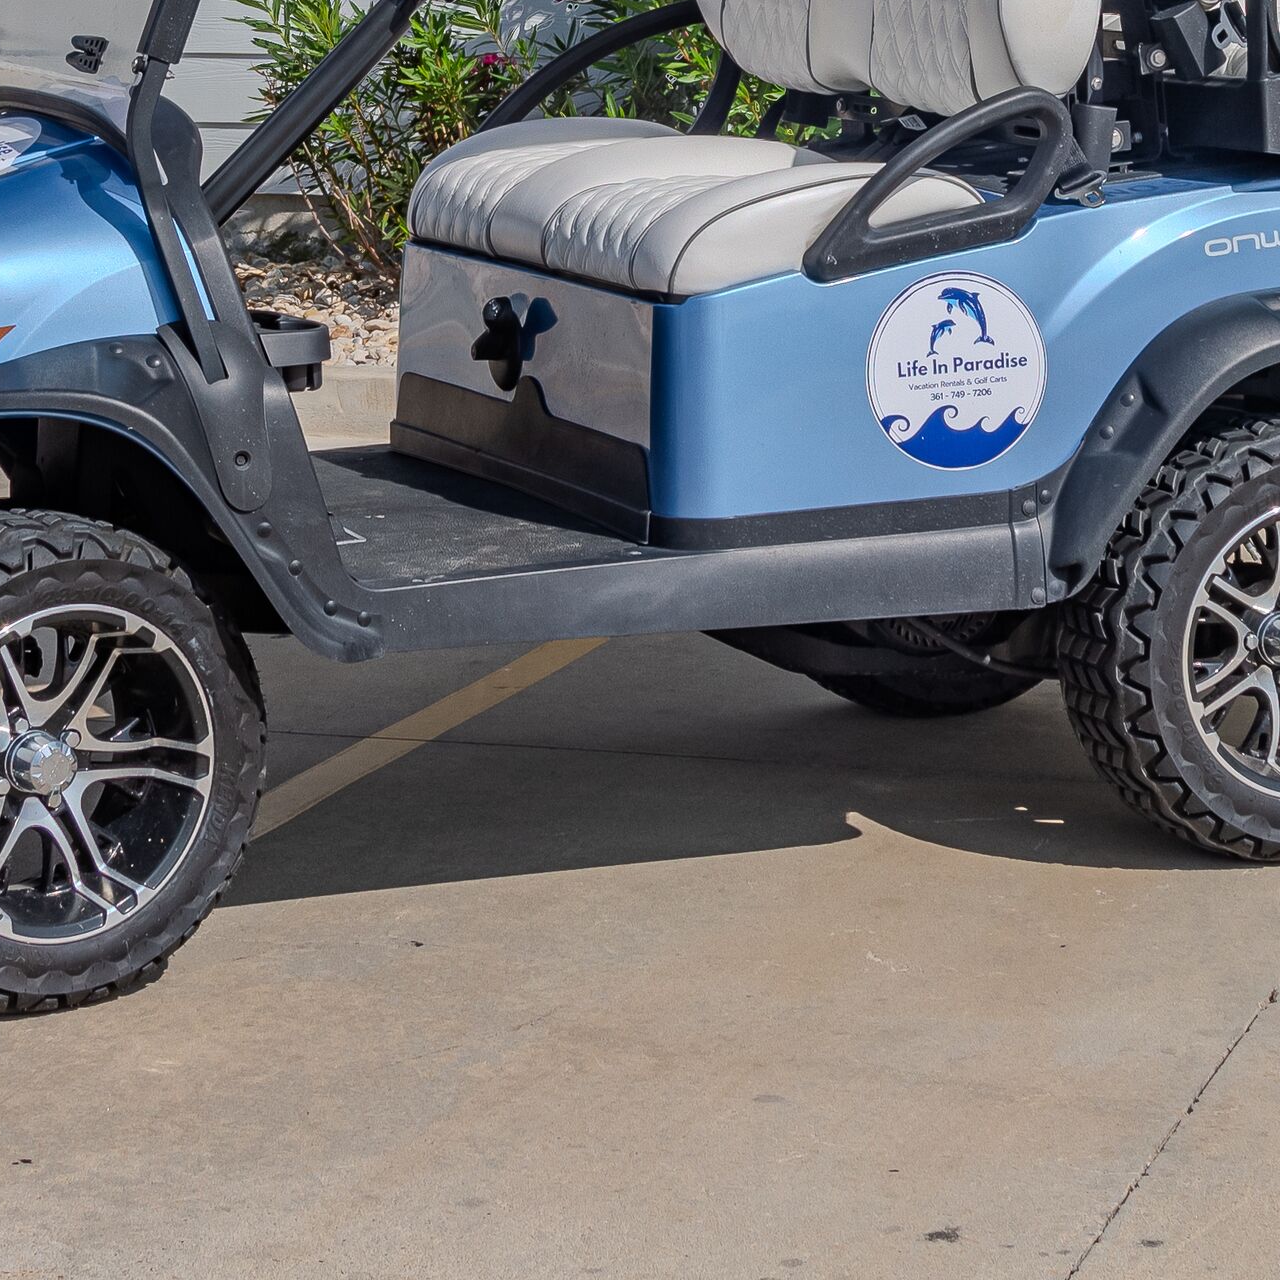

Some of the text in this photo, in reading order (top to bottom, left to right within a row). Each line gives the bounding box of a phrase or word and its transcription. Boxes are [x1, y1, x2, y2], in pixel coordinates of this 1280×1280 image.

[897, 352, 1028, 378] Life In Paradise
[908, 383, 939, 391] Vacation
[940, 379, 965, 388] Rentals
[974, 376, 988, 385] Golf
[989, 375, 1008, 383] Carts
[930, 392, 944, 401] 361
[951, 390, 965, 399] 749
[972, 387, 992, 397] 7206
